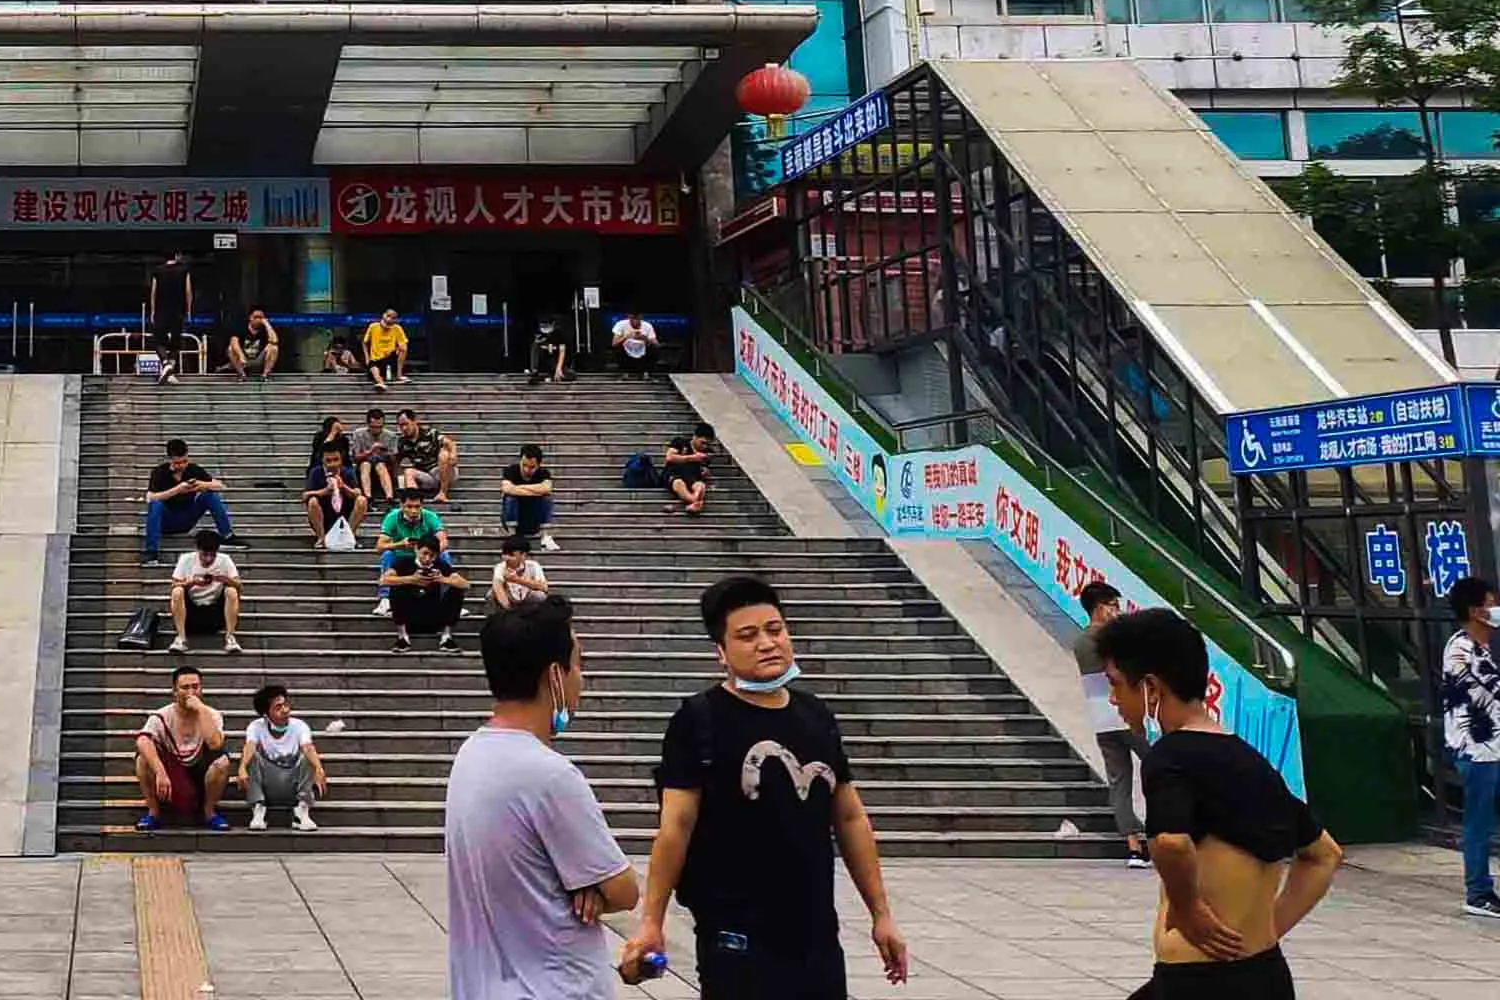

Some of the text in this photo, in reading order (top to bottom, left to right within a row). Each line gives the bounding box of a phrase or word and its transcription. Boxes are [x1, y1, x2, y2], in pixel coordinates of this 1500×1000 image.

[385, 185, 652, 225] 龙观人才大市场
[1365, 520, 1472, 599] 电梯
